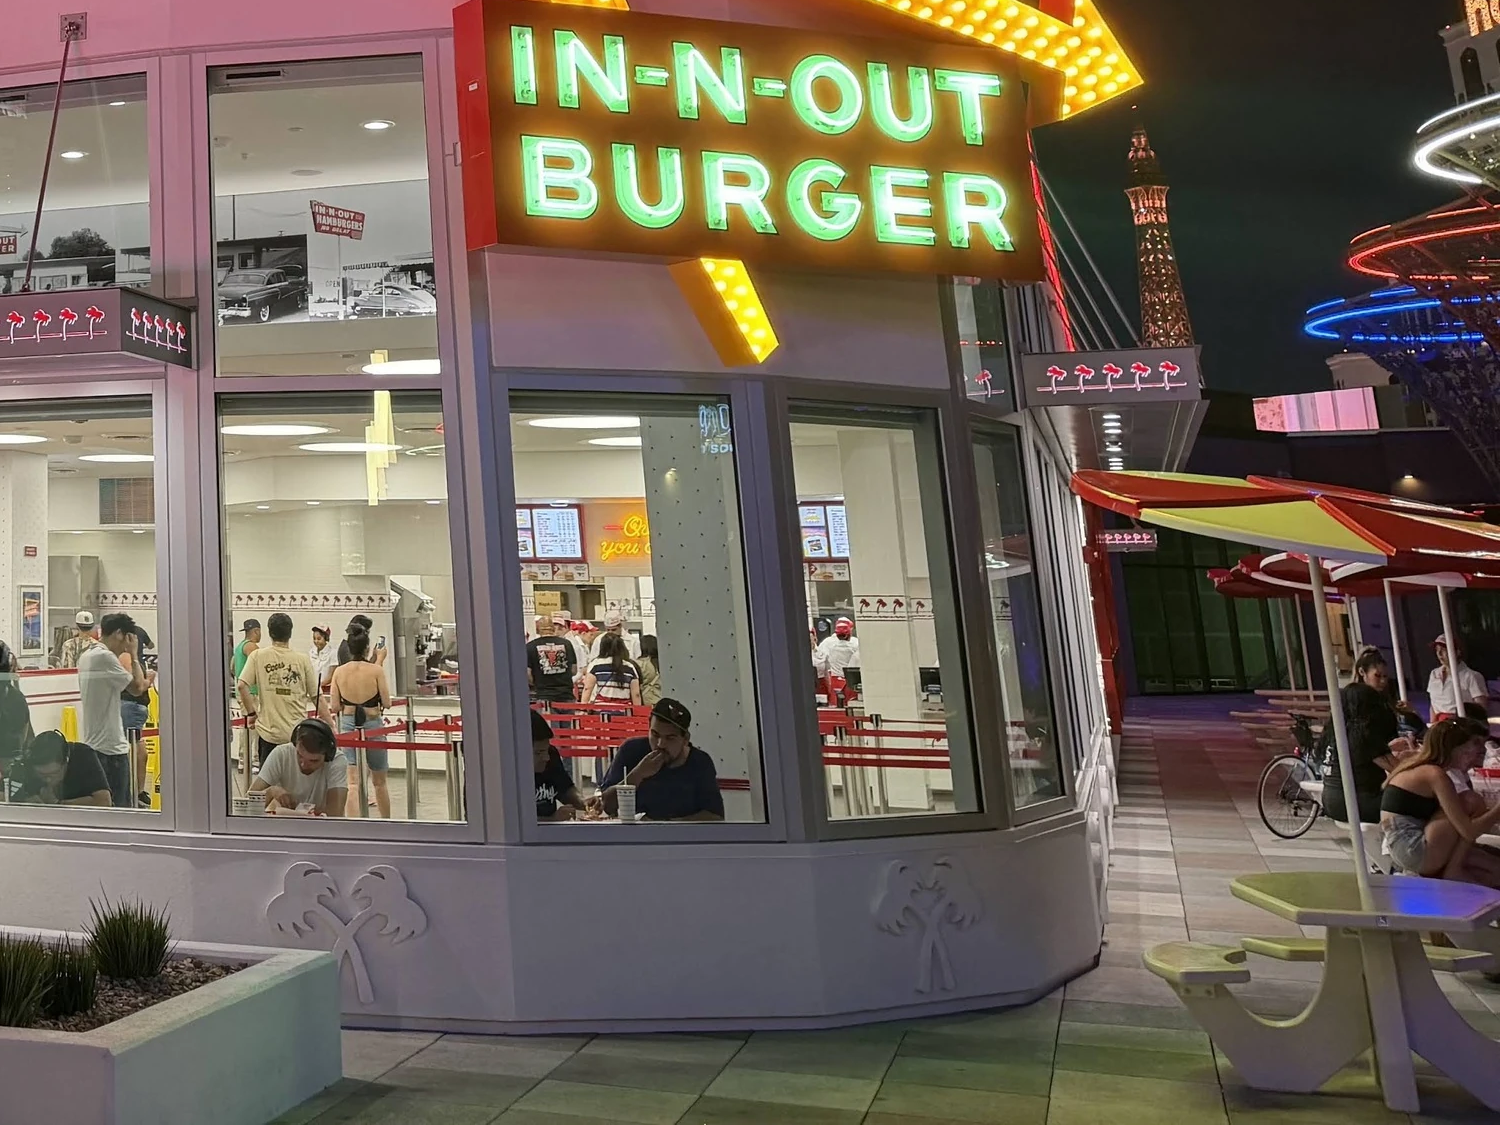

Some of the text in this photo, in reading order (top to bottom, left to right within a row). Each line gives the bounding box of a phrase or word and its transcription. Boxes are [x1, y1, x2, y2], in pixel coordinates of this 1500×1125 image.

[510, 25, 1002, 146] IN-N-OUT
[316, 215, 363, 230] HAMBURGERS
[520, 134, 1016, 252] BURGER
[601, 541, 639, 561] you
